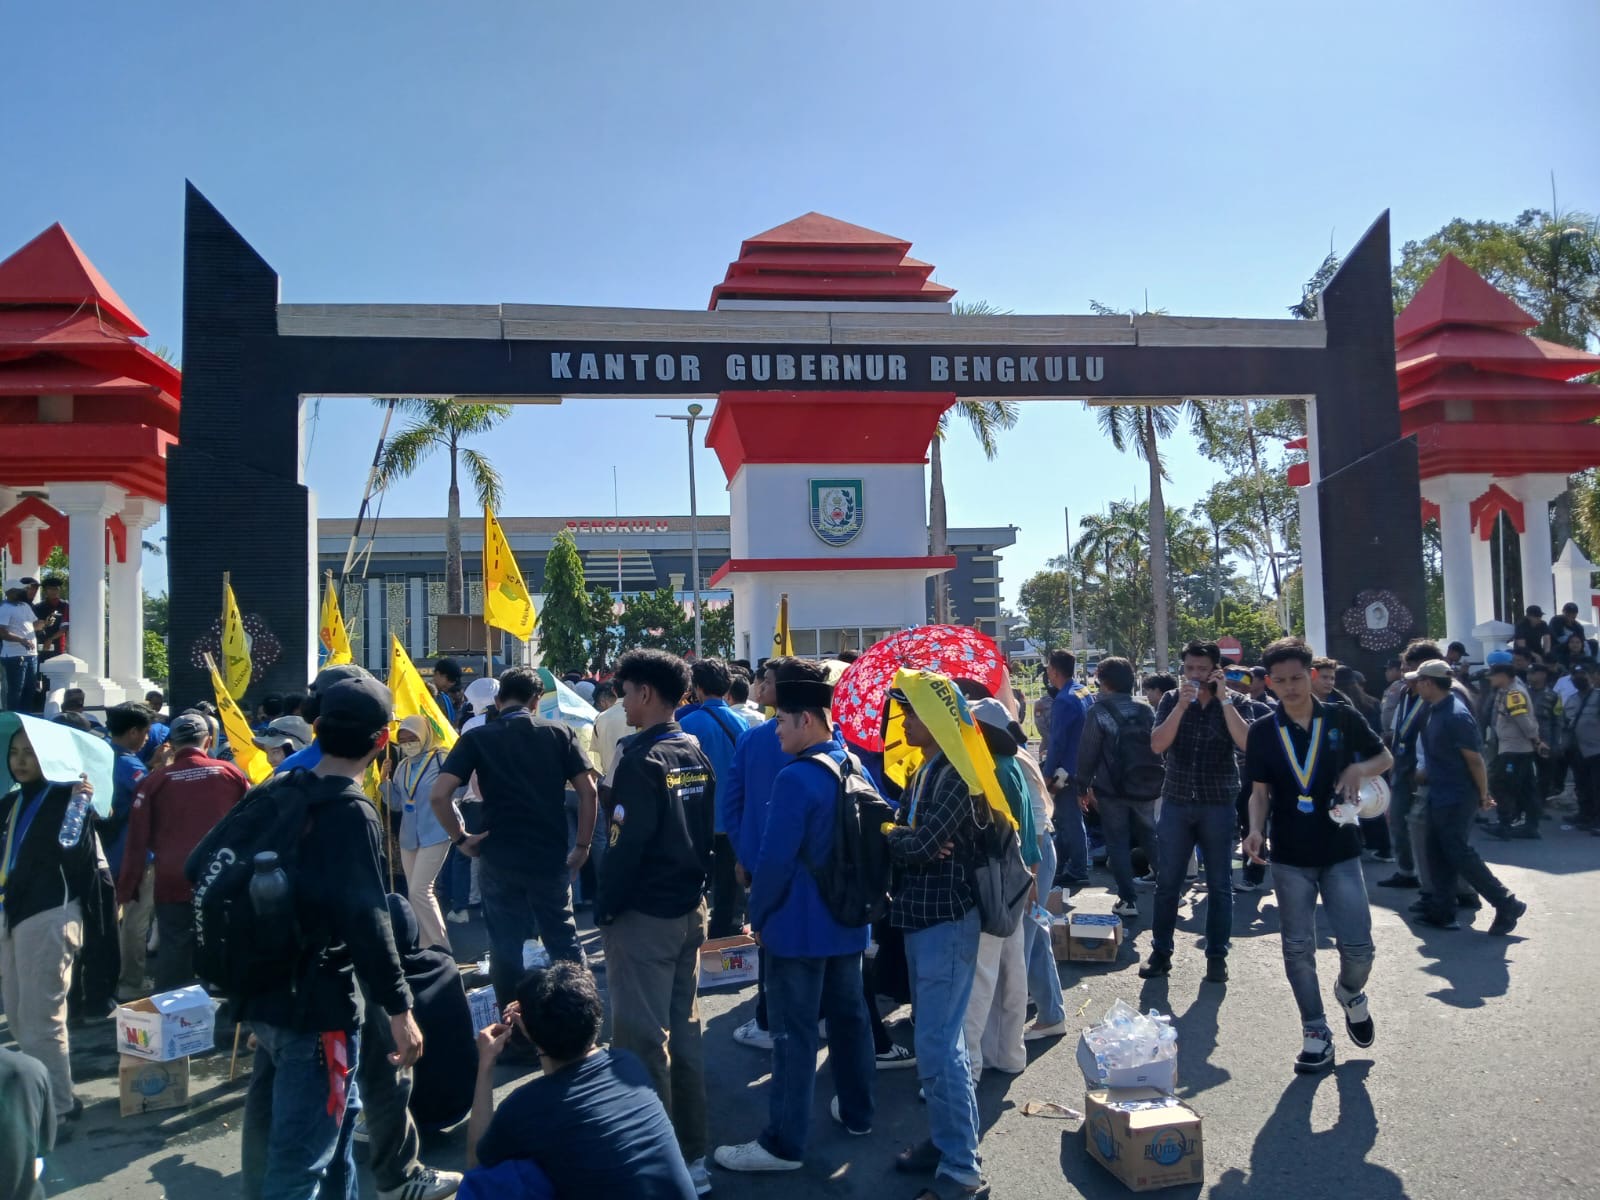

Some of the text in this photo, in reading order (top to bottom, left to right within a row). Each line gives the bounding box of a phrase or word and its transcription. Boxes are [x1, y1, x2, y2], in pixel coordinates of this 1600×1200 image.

[551, 352, 1105, 382] KANTOR GUBERNUR BENGKULU
[566, 520, 669, 533] BENGKULU
